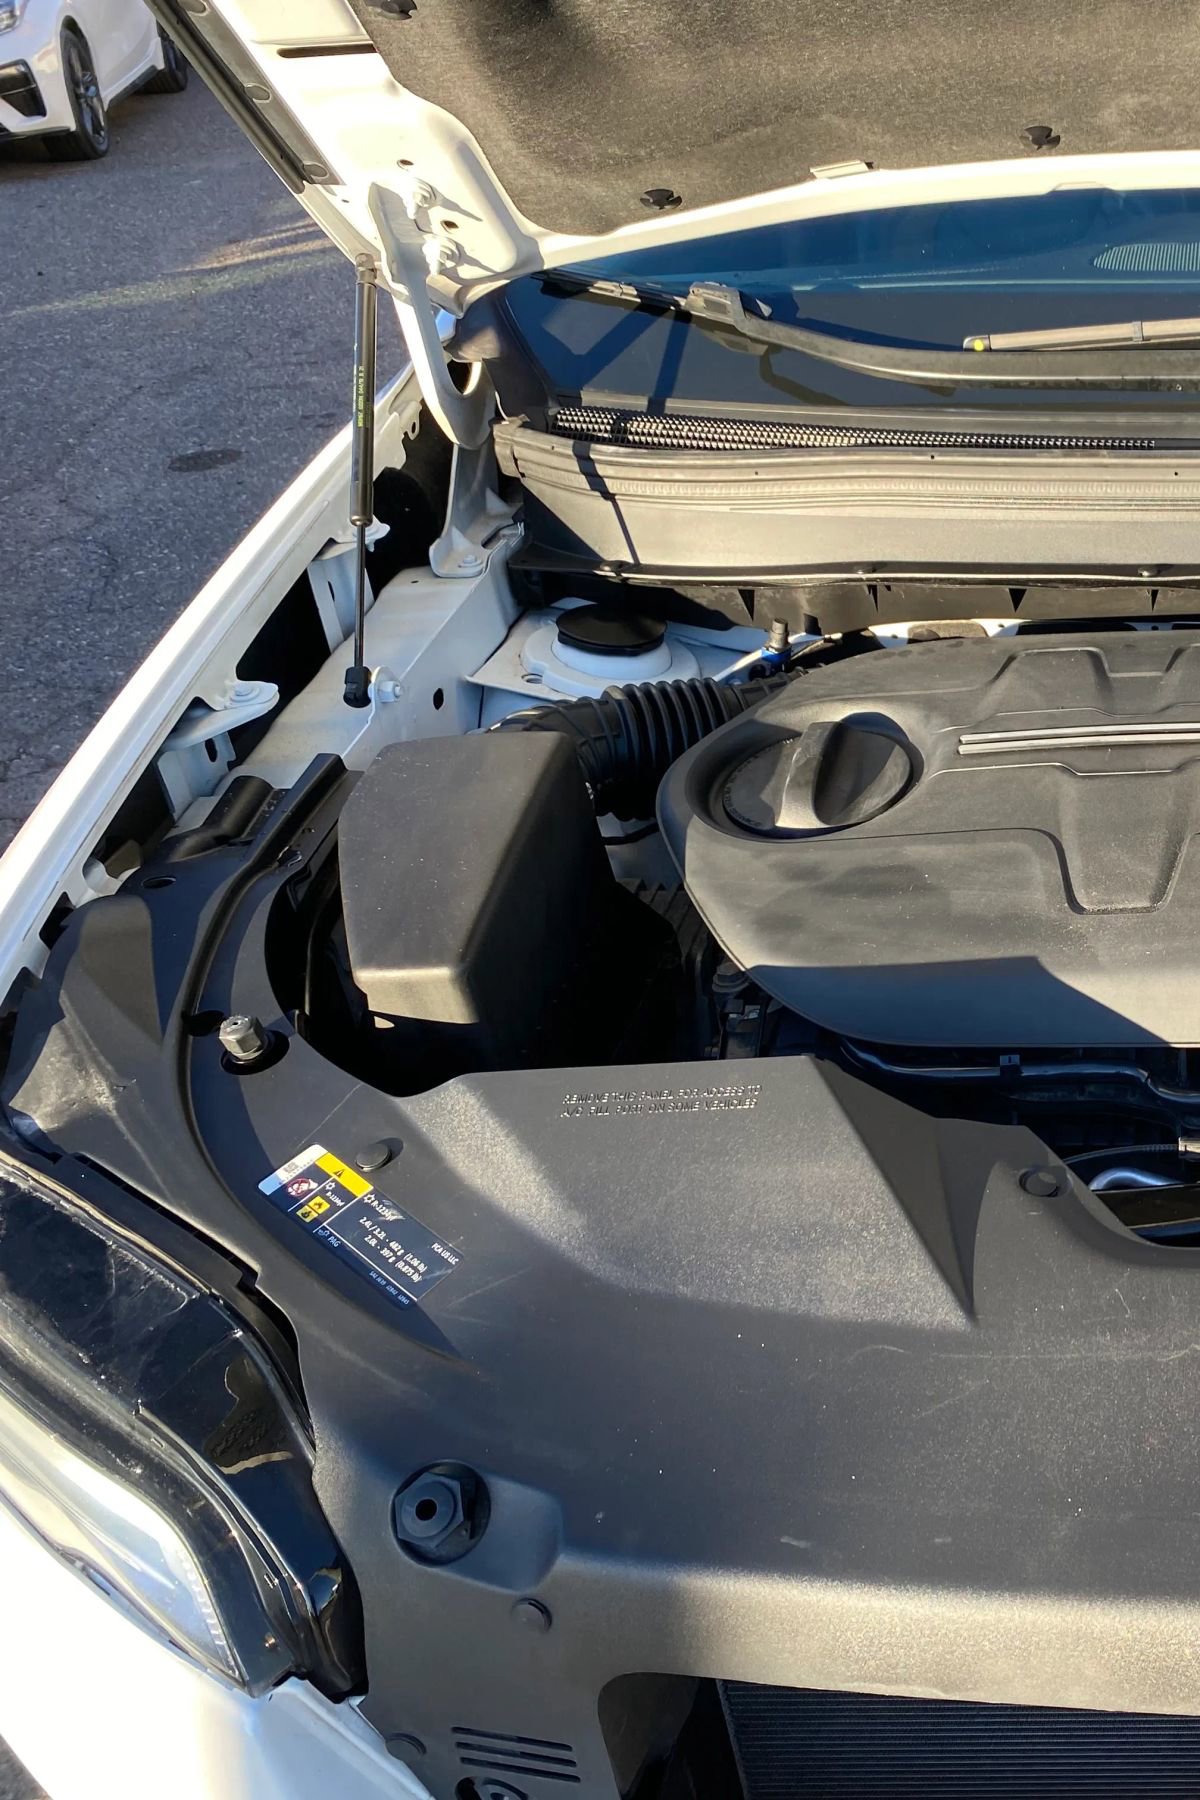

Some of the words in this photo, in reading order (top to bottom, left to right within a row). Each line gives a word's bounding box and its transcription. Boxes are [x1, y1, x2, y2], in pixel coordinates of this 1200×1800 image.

[562, 1092, 609, 1104] REMOVE
[611, 1090, 637, 1102] THIS
[639, 1089, 674, 1101] PANEL
[677, 1087, 699, 1099] FOR
[700, 1086, 745, 1098] ACCESS
[747, 1084, 762, 1096] TO
[588, 1105, 610, 1116] FILL
[614, 1104, 645, 1115] PORT
[648, 1102, 666, 1114] ON
[667, 1100, 700, 1112] SOME
[704, 1098, 758, 1111] VEHICLES
[327, 1234, 341, 1248] PAG
[431, 1242, 443, 1254] FCA
[447, 1255, 459, 1265] LLC
